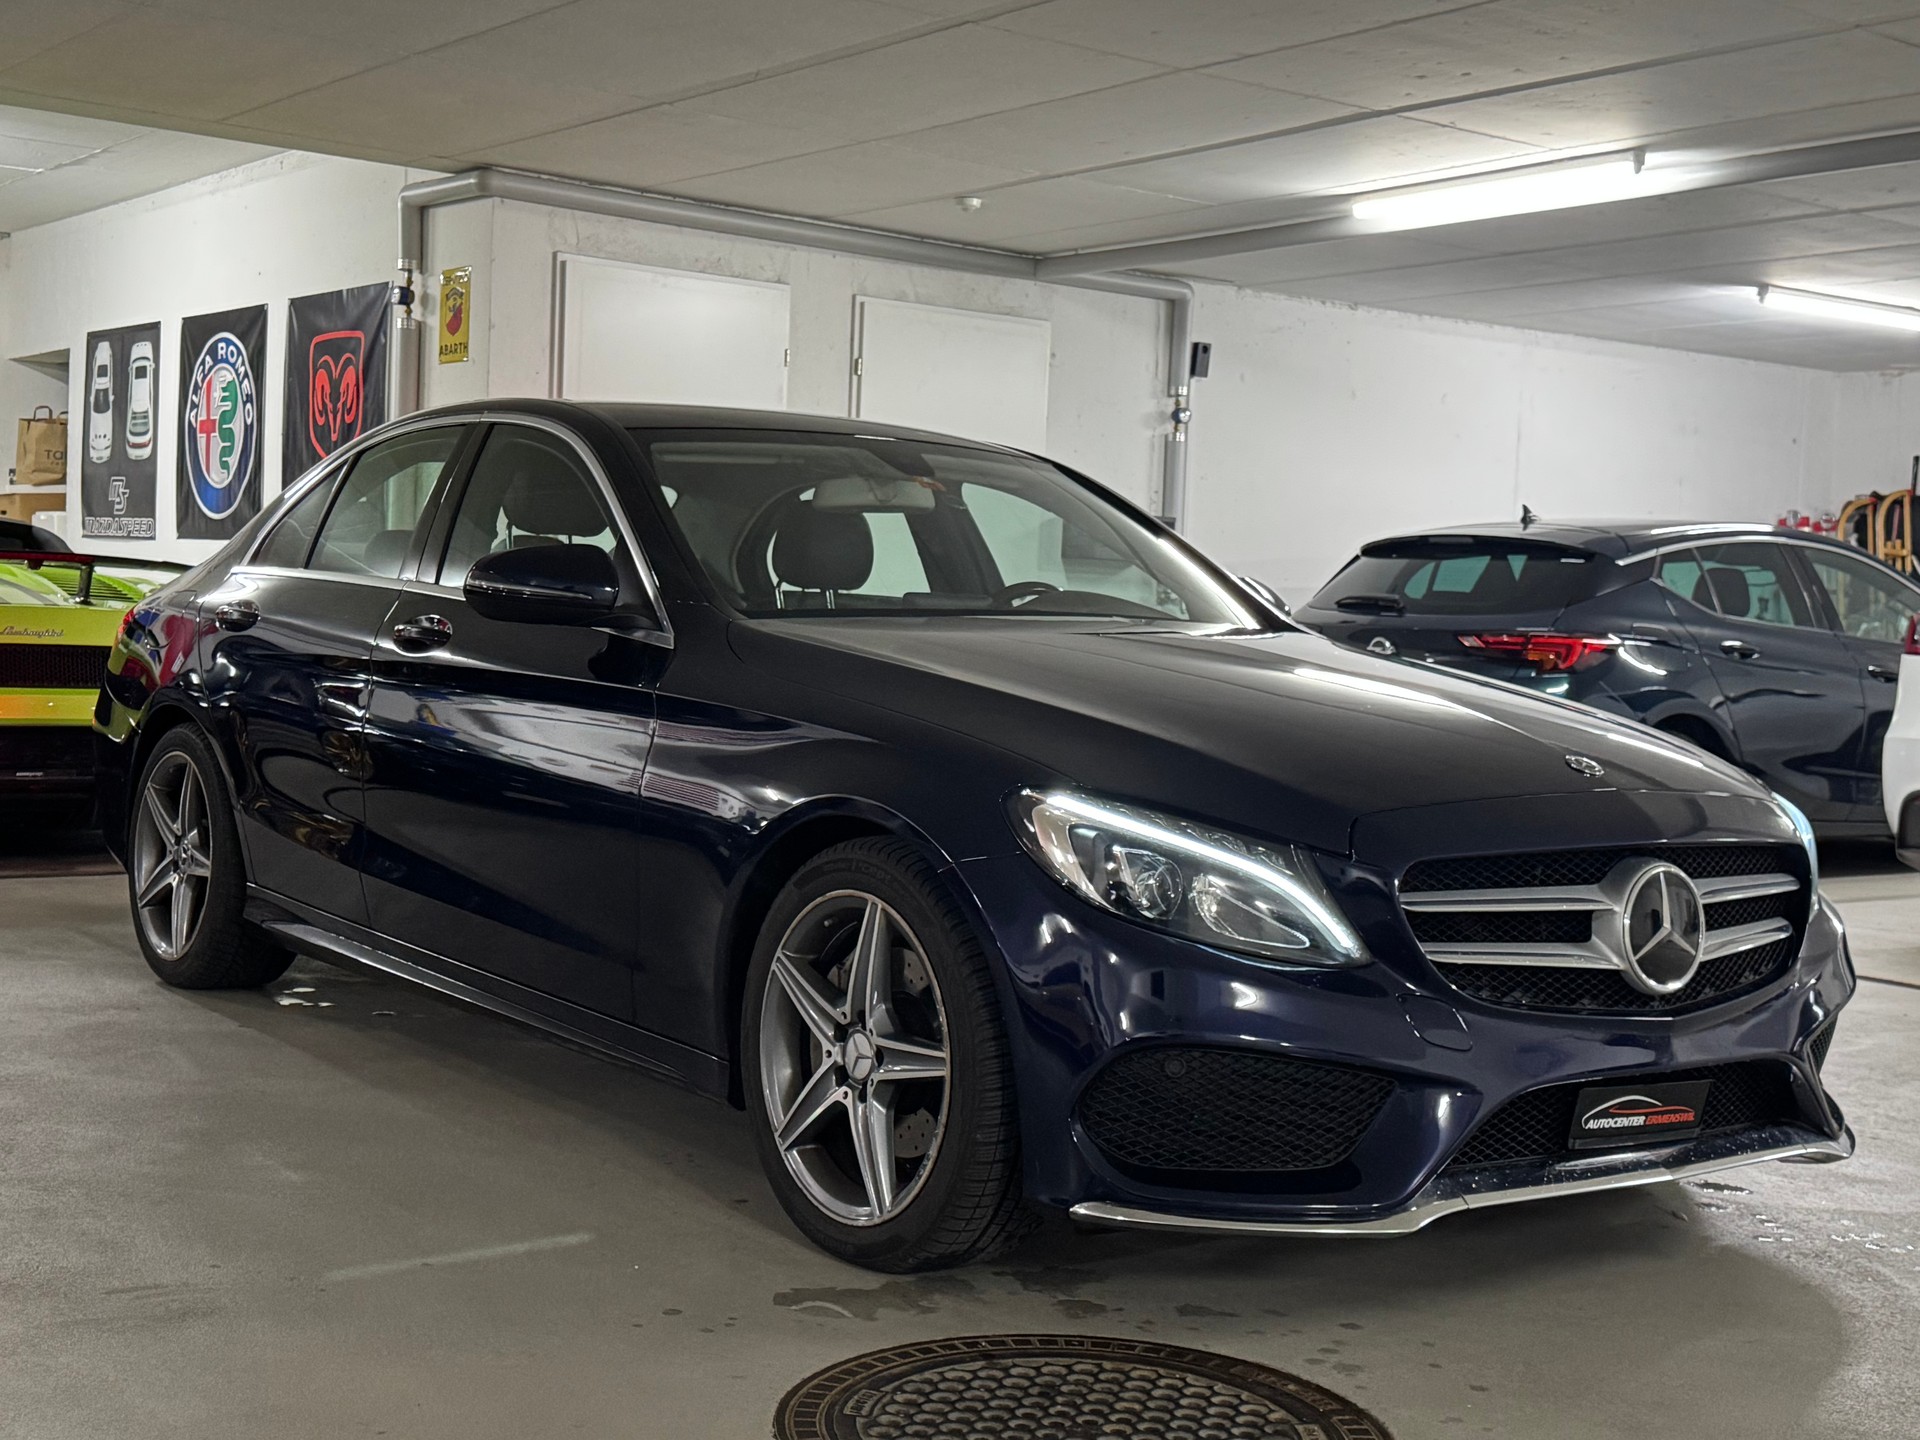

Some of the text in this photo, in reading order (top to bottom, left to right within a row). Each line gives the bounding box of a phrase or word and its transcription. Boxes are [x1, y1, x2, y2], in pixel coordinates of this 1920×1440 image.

[439, 342, 468, 356] ABARTH
[190, 341, 253, 428] ALFA ROMEO
[85, 516, 155, 537] MAZDASPEED
[1585, 1116, 1646, 1130] AUTOCENTER
